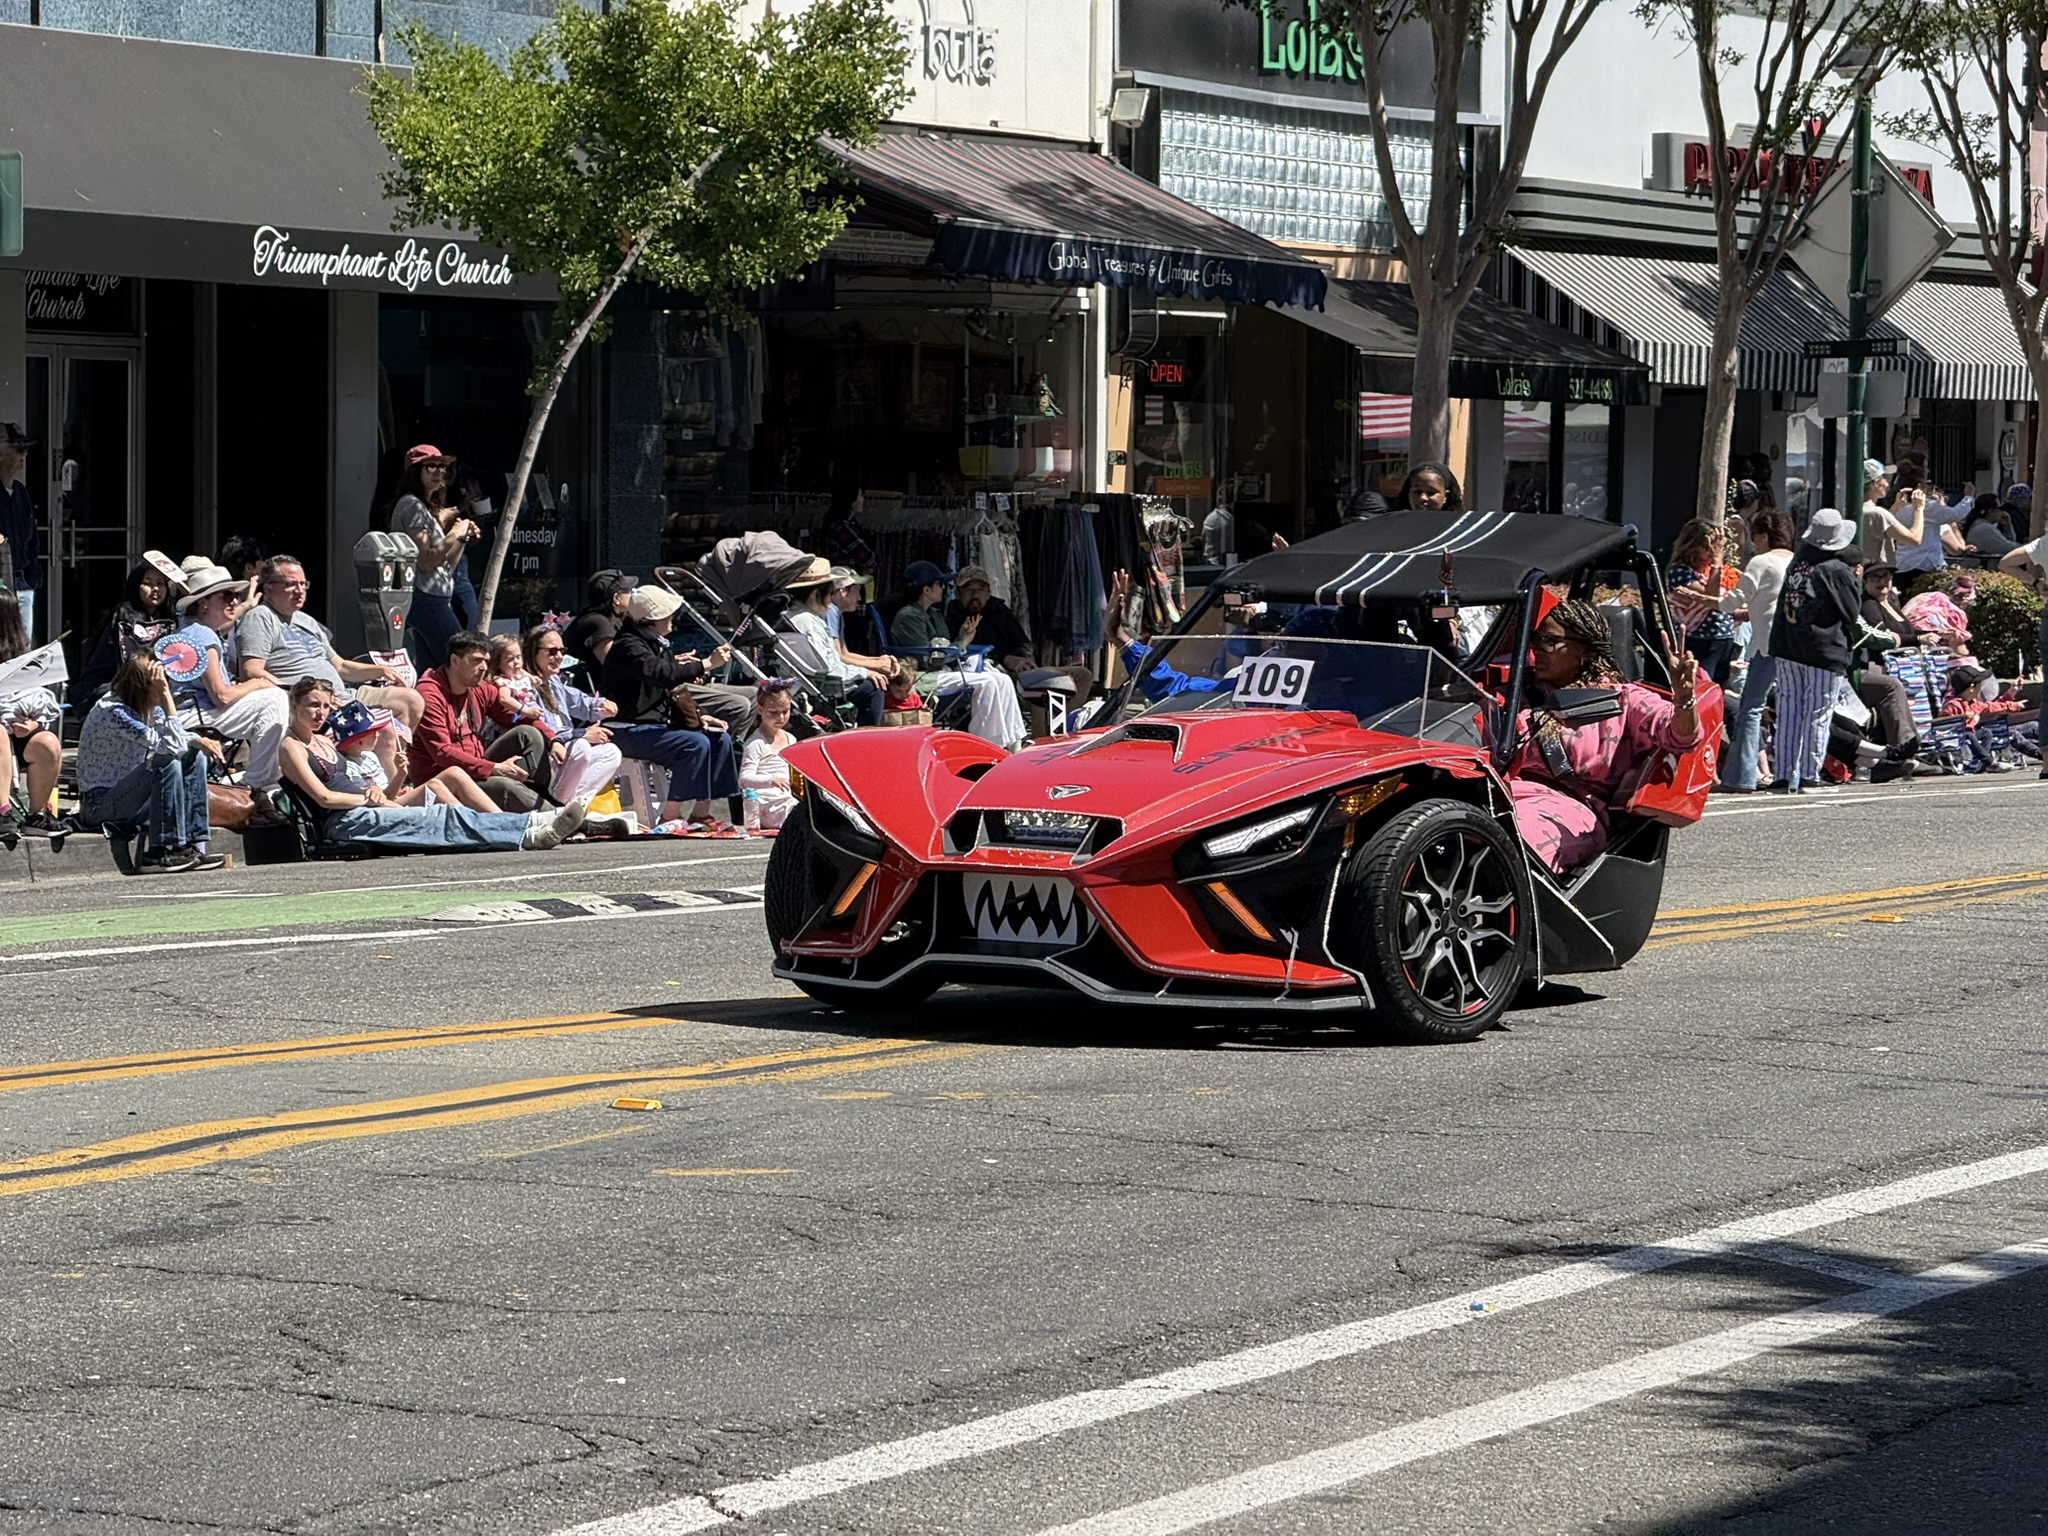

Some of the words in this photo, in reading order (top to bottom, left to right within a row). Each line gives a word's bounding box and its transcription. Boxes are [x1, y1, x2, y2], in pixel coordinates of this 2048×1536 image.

[253, 225, 387, 286] Triumphant
[388, 238, 433, 292] Life
[435, 242, 513, 286] Church
[1048, 242, 1091, 271] Global
[1092, 247, 1146, 277] Treasures
[1158, 256, 1200, 291] Unique
[1202, 260, 1233, 287] Gifts
[27, 289, 86, 320] Church
[1150, 364, 1183, 383] OPEN
[1496, 367, 1531, 397] Lola's
[494, 526, 557, 548] dnesday
[513, 553, 520, 569] 7
[522, 556, 539, 574] pm
[1239, 662, 1304, 698] 109
